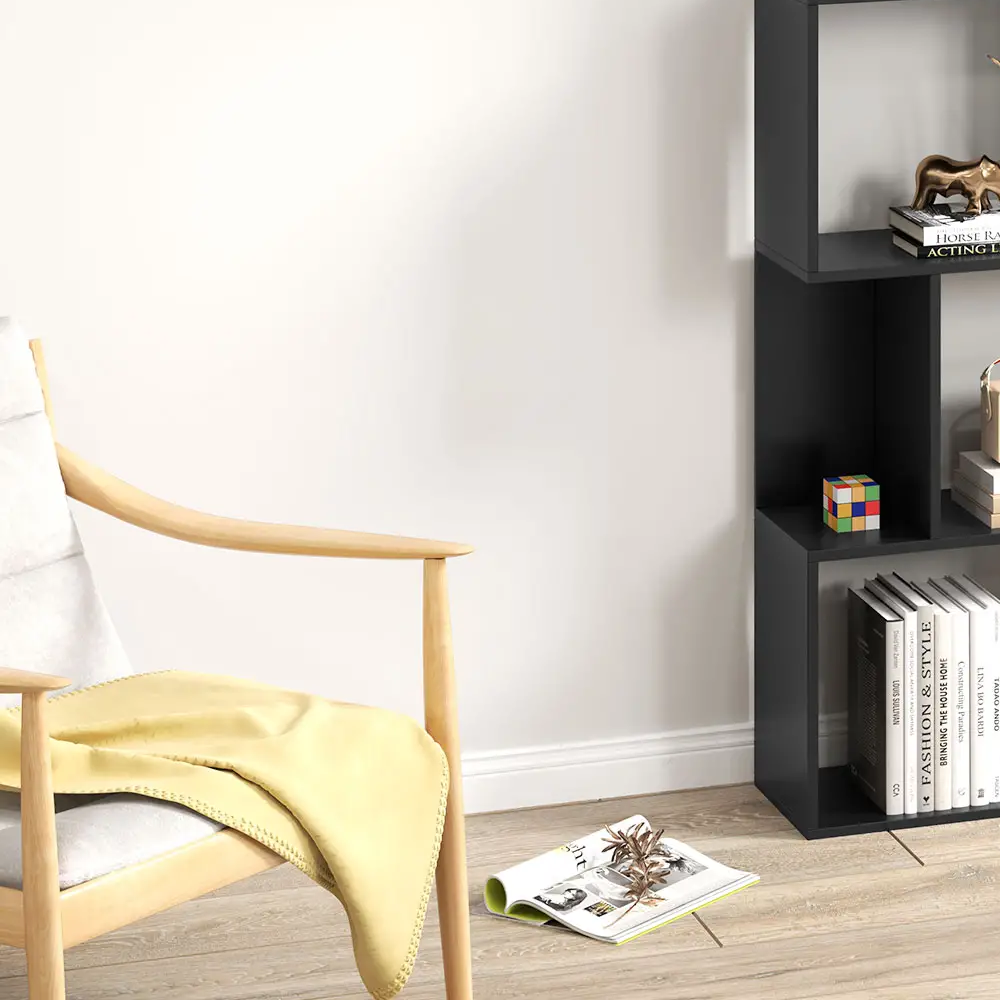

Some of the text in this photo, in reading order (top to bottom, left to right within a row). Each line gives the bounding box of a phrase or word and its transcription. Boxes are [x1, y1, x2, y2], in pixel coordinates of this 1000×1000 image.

[927, 244, 987, 258] ACTING
[892, 680, 900, 726] LOUIS SULLIVAN
[921, 621, 932, 786] FASHION & STYLE
[956, 661, 966, 710] Constructing
[977, 692, 984, 705] BO
[939, 657, 948, 766] BRINGING THE HOUSE HOME
[893, 783, 901, 797] CCA
